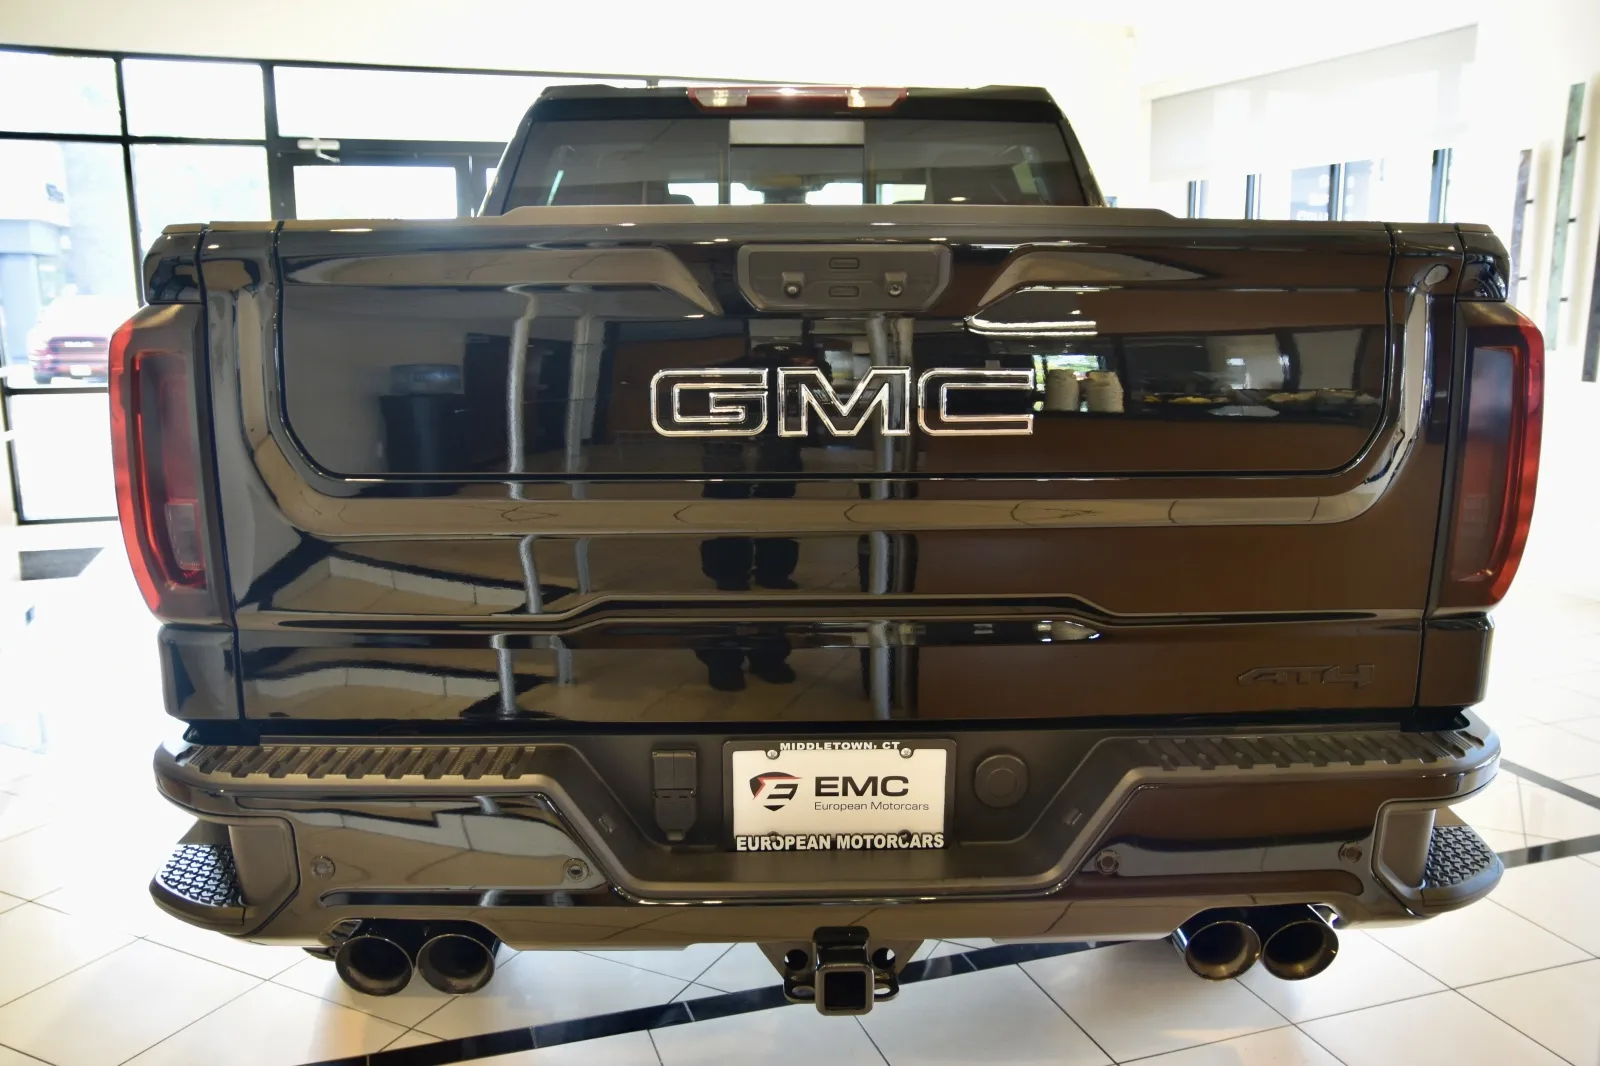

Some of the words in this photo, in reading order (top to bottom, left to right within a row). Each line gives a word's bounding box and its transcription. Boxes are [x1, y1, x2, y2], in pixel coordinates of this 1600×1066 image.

[650, 366, 1035, 438] GMC
[1237, 663, 1375, 689] AT4
[780, 742, 877, 751] MIDDLETOWN,
[882, 741, 900, 750] CT
[815, 776, 909, 797] EMC
[814, 802, 867, 812] European
[871, 801, 929, 811] Motorcars
[736, 835, 831, 851] EUROPEAN
[836, 833, 944, 849] MOTORCARS
